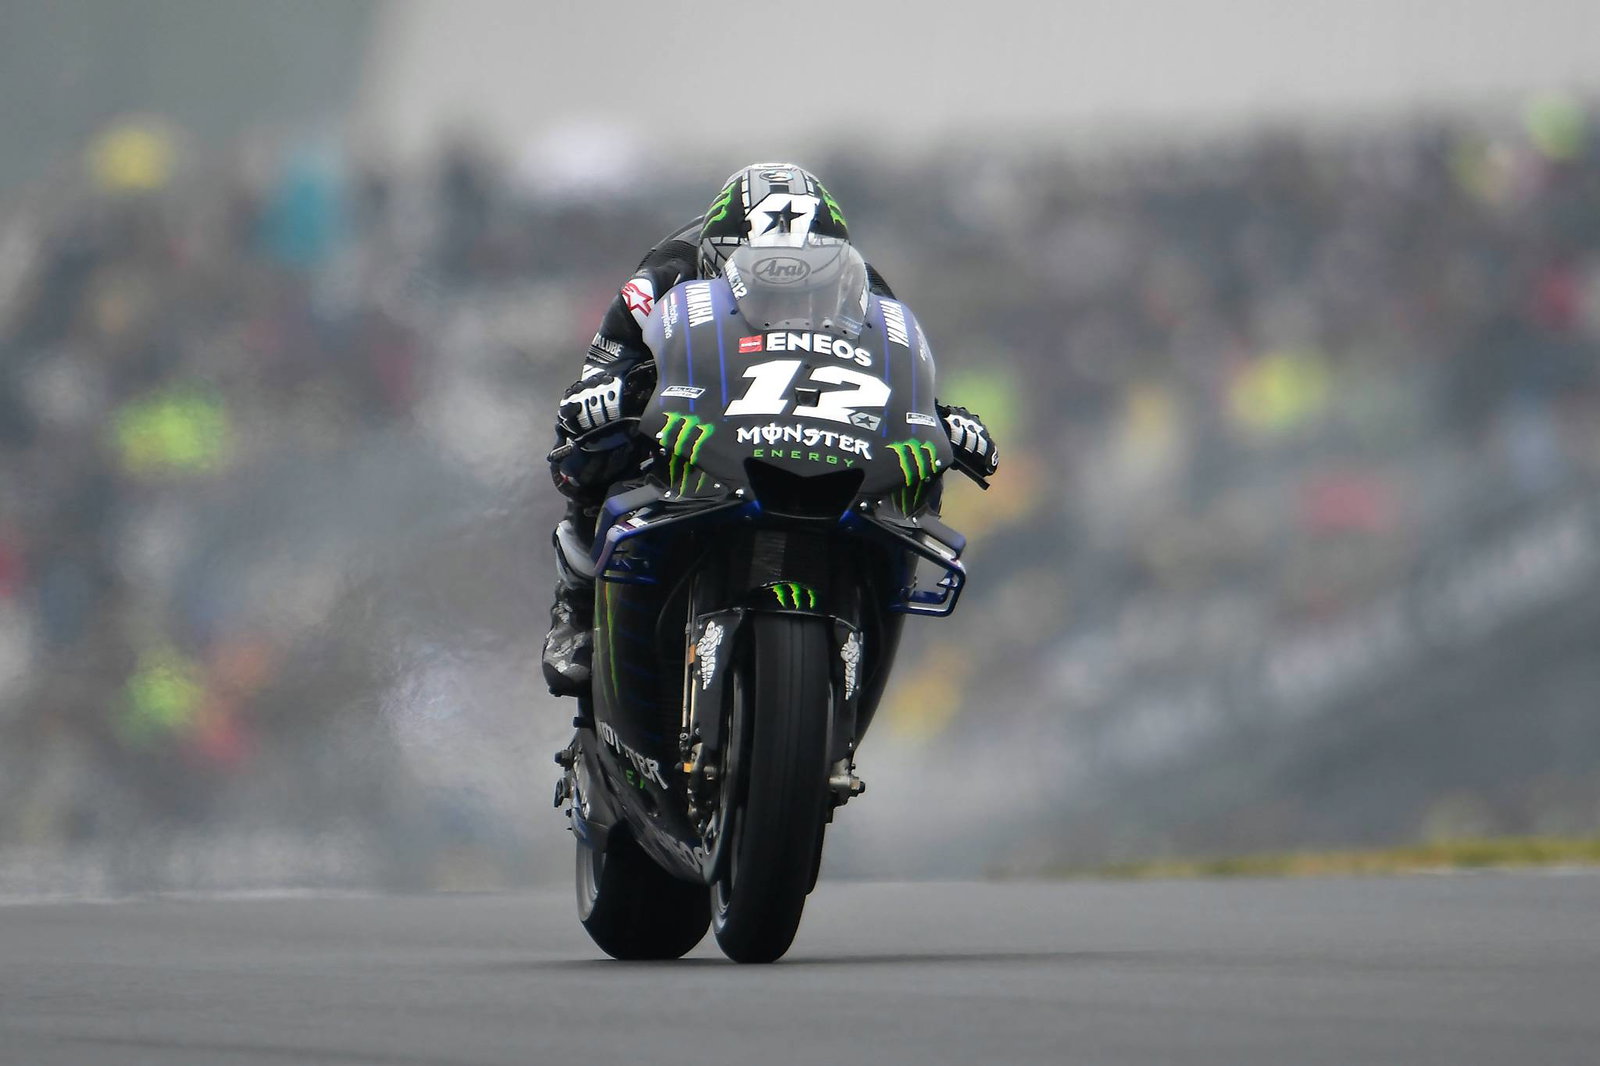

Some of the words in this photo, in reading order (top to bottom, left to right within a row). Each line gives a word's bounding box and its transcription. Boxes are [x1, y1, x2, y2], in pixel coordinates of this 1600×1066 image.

[685, 282, 714, 327] YAMAHA
[879, 300, 909, 347] YAMAHA
[766, 332, 872, 367] ENEOS
[724, 360, 892, 424] 12
[736, 422, 872, 460] MONSTER
[753, 449, 855, 468] ENERGY
